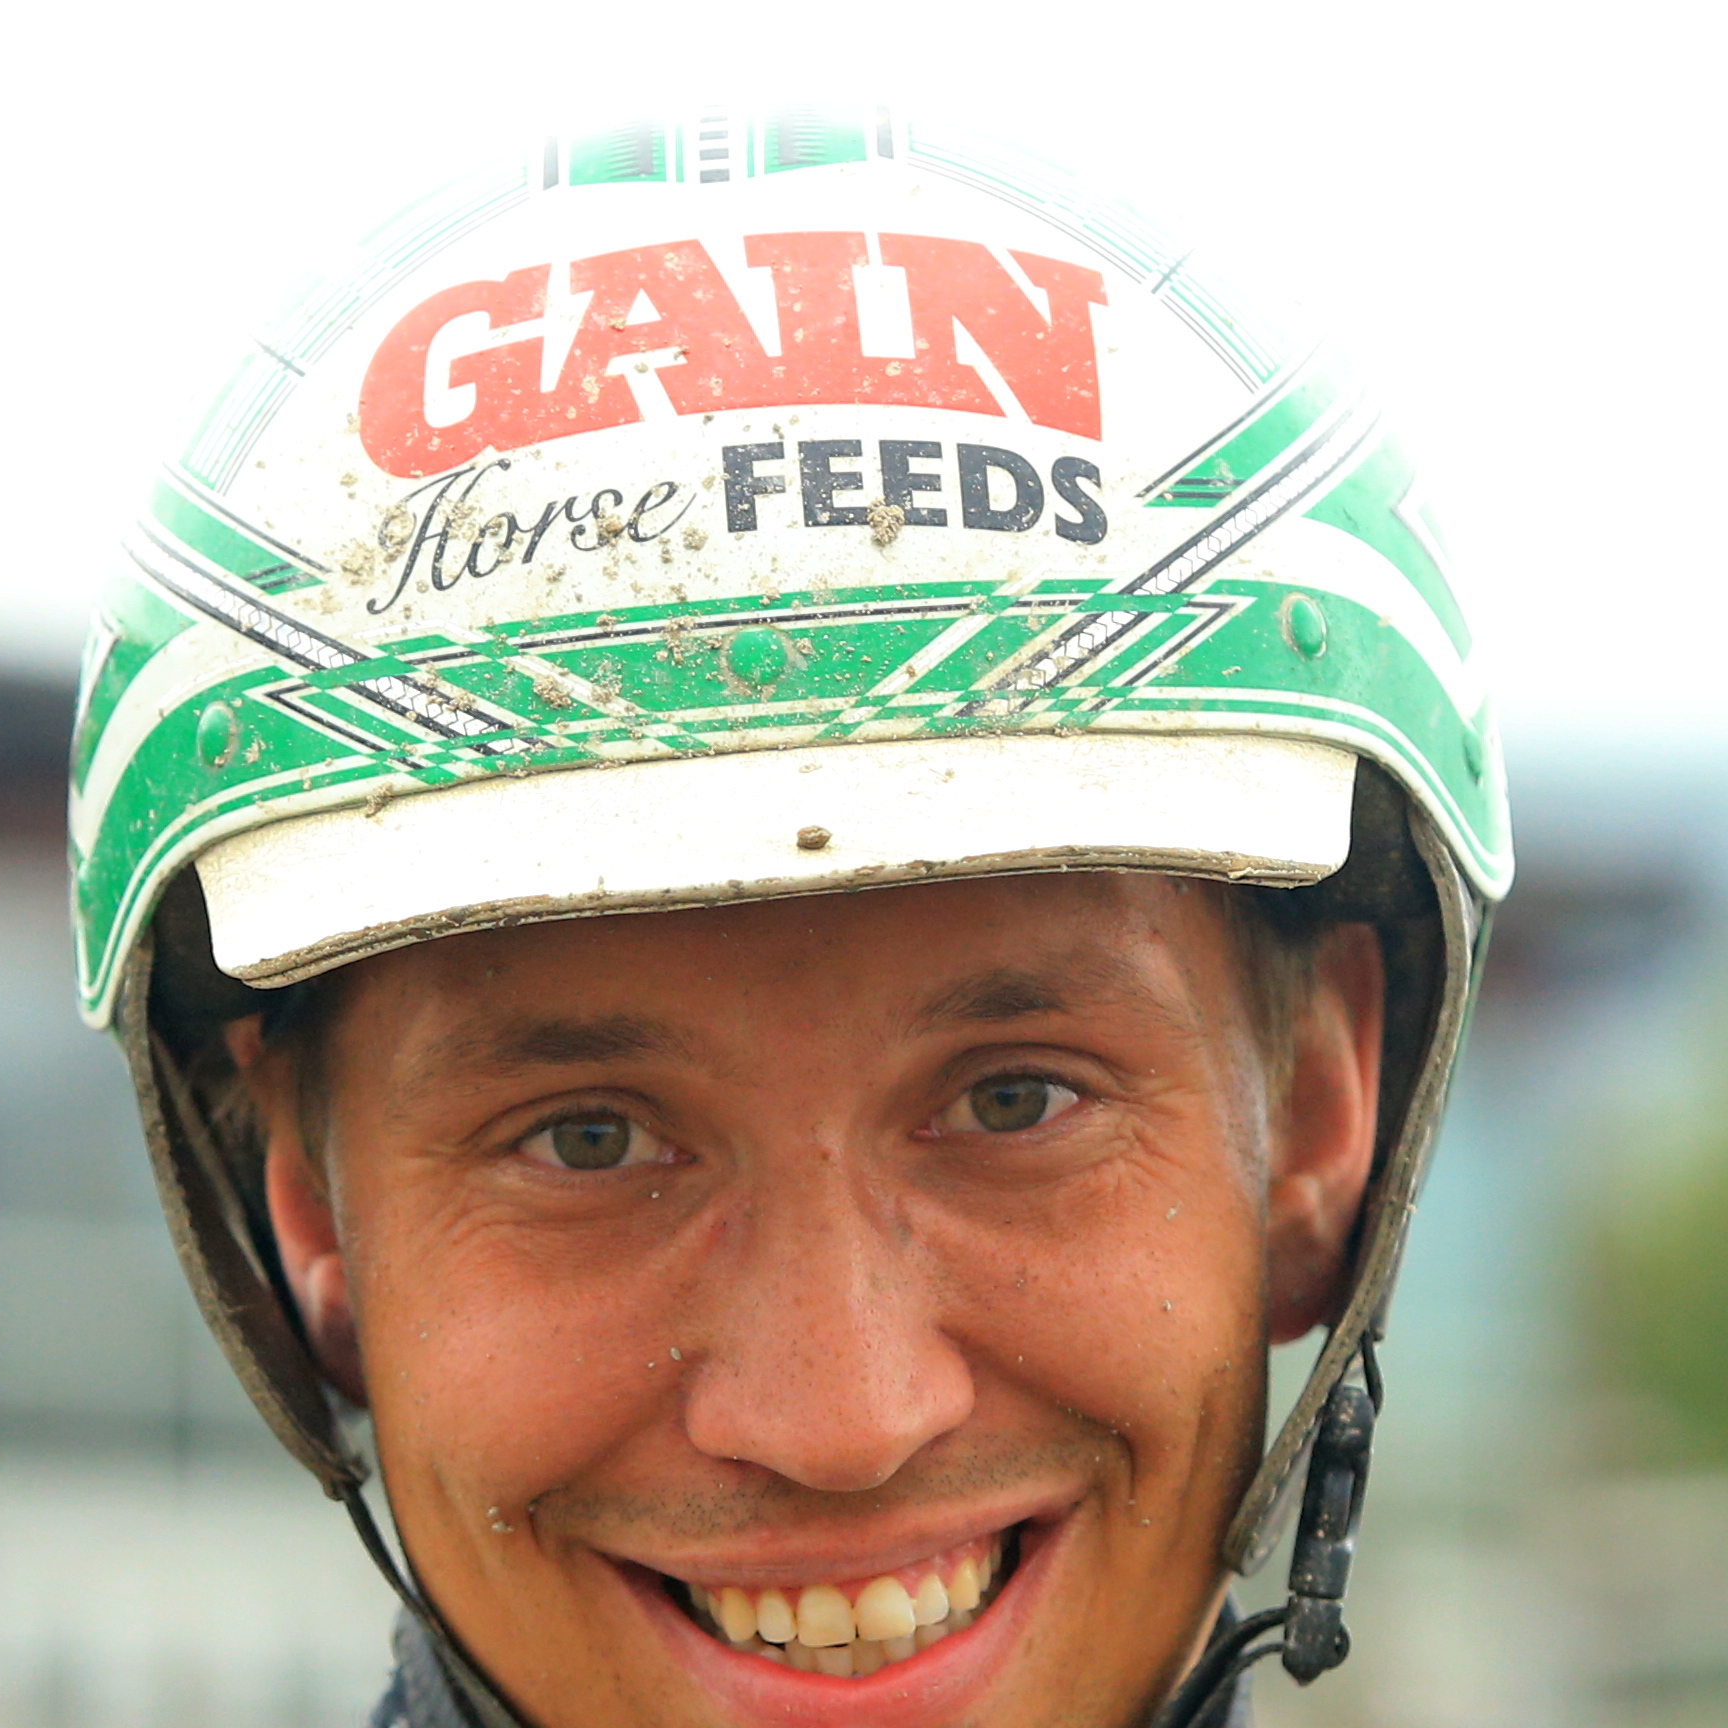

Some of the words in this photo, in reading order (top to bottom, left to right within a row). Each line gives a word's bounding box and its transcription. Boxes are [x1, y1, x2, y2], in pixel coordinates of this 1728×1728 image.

[360, 231, 1109, 476] GAIN
[366, 458, 696, 614] Horse
[722, 440, 1109, 544] FEEDS
